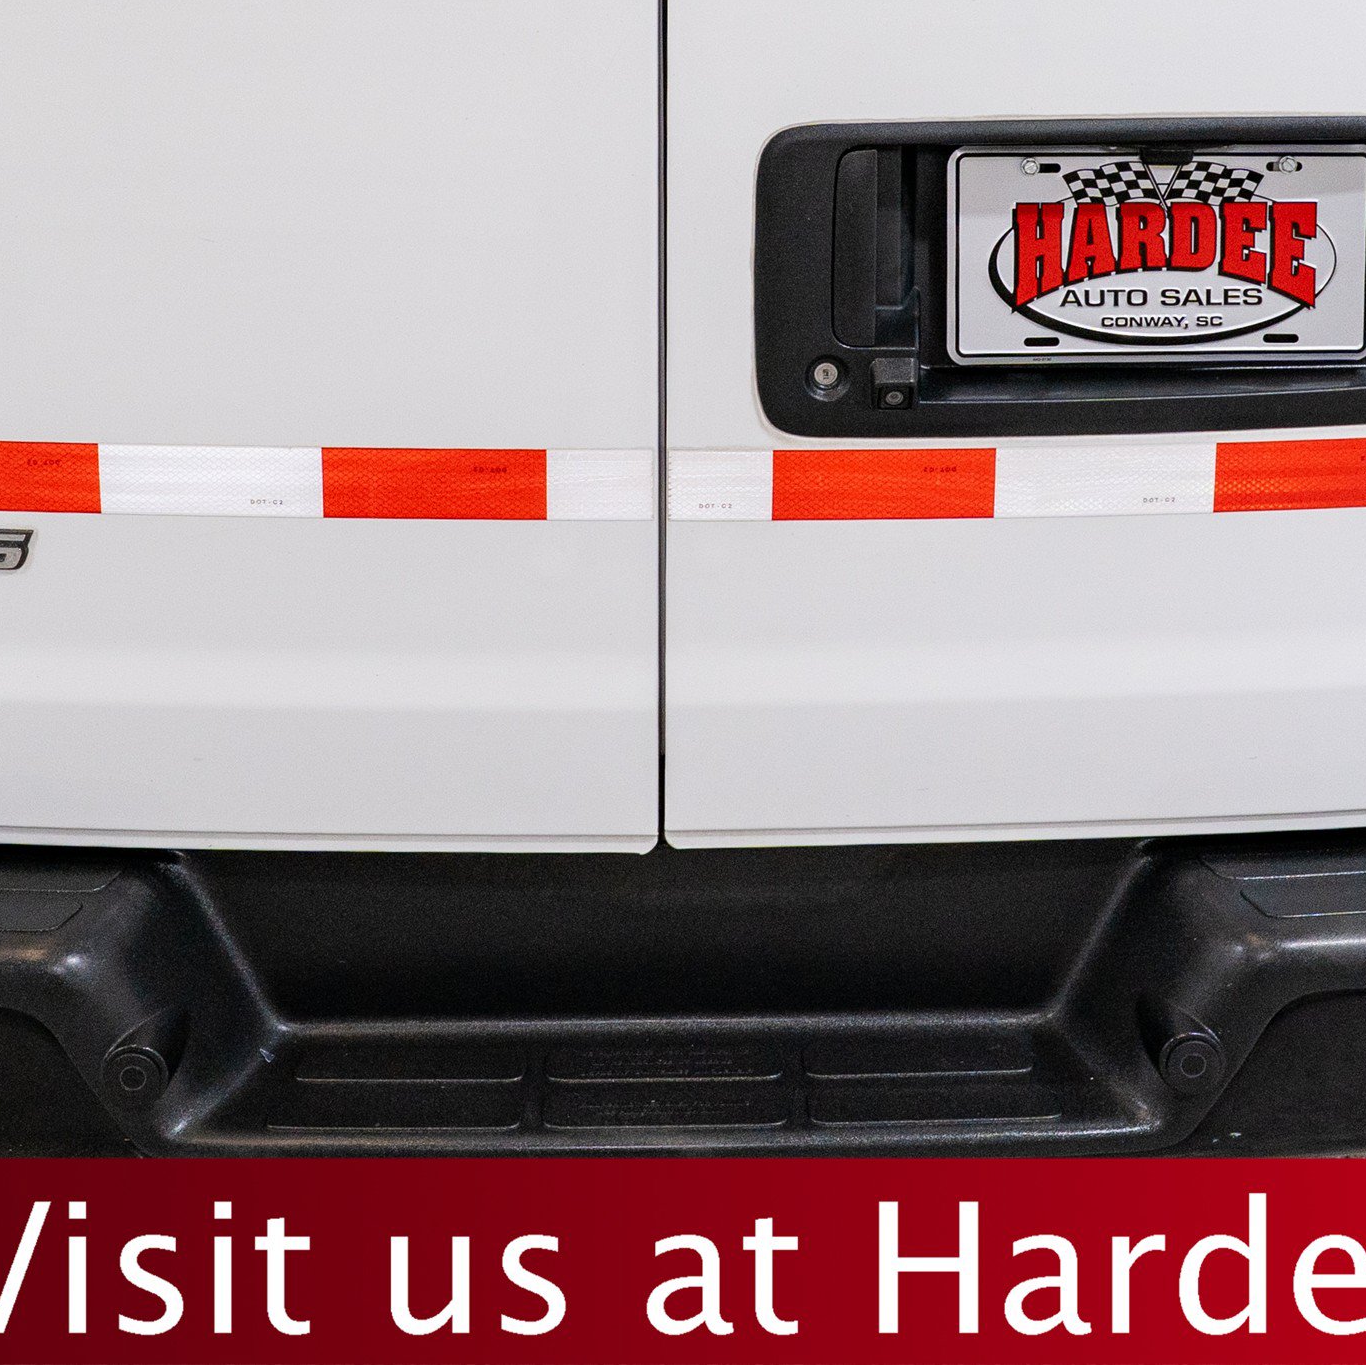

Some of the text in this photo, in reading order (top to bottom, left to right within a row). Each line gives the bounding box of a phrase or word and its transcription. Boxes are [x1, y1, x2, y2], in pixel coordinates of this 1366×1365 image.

[1012, 201, 1318, 313] HARDEE
[1060, 287, 1263, 307] AUTO SALES
[1101, 316, 1223, 330] CONWAY, SC
[698, 502, 733, 510] DOT-C2
[1142, 496, 1176, 504] DOT-C2
